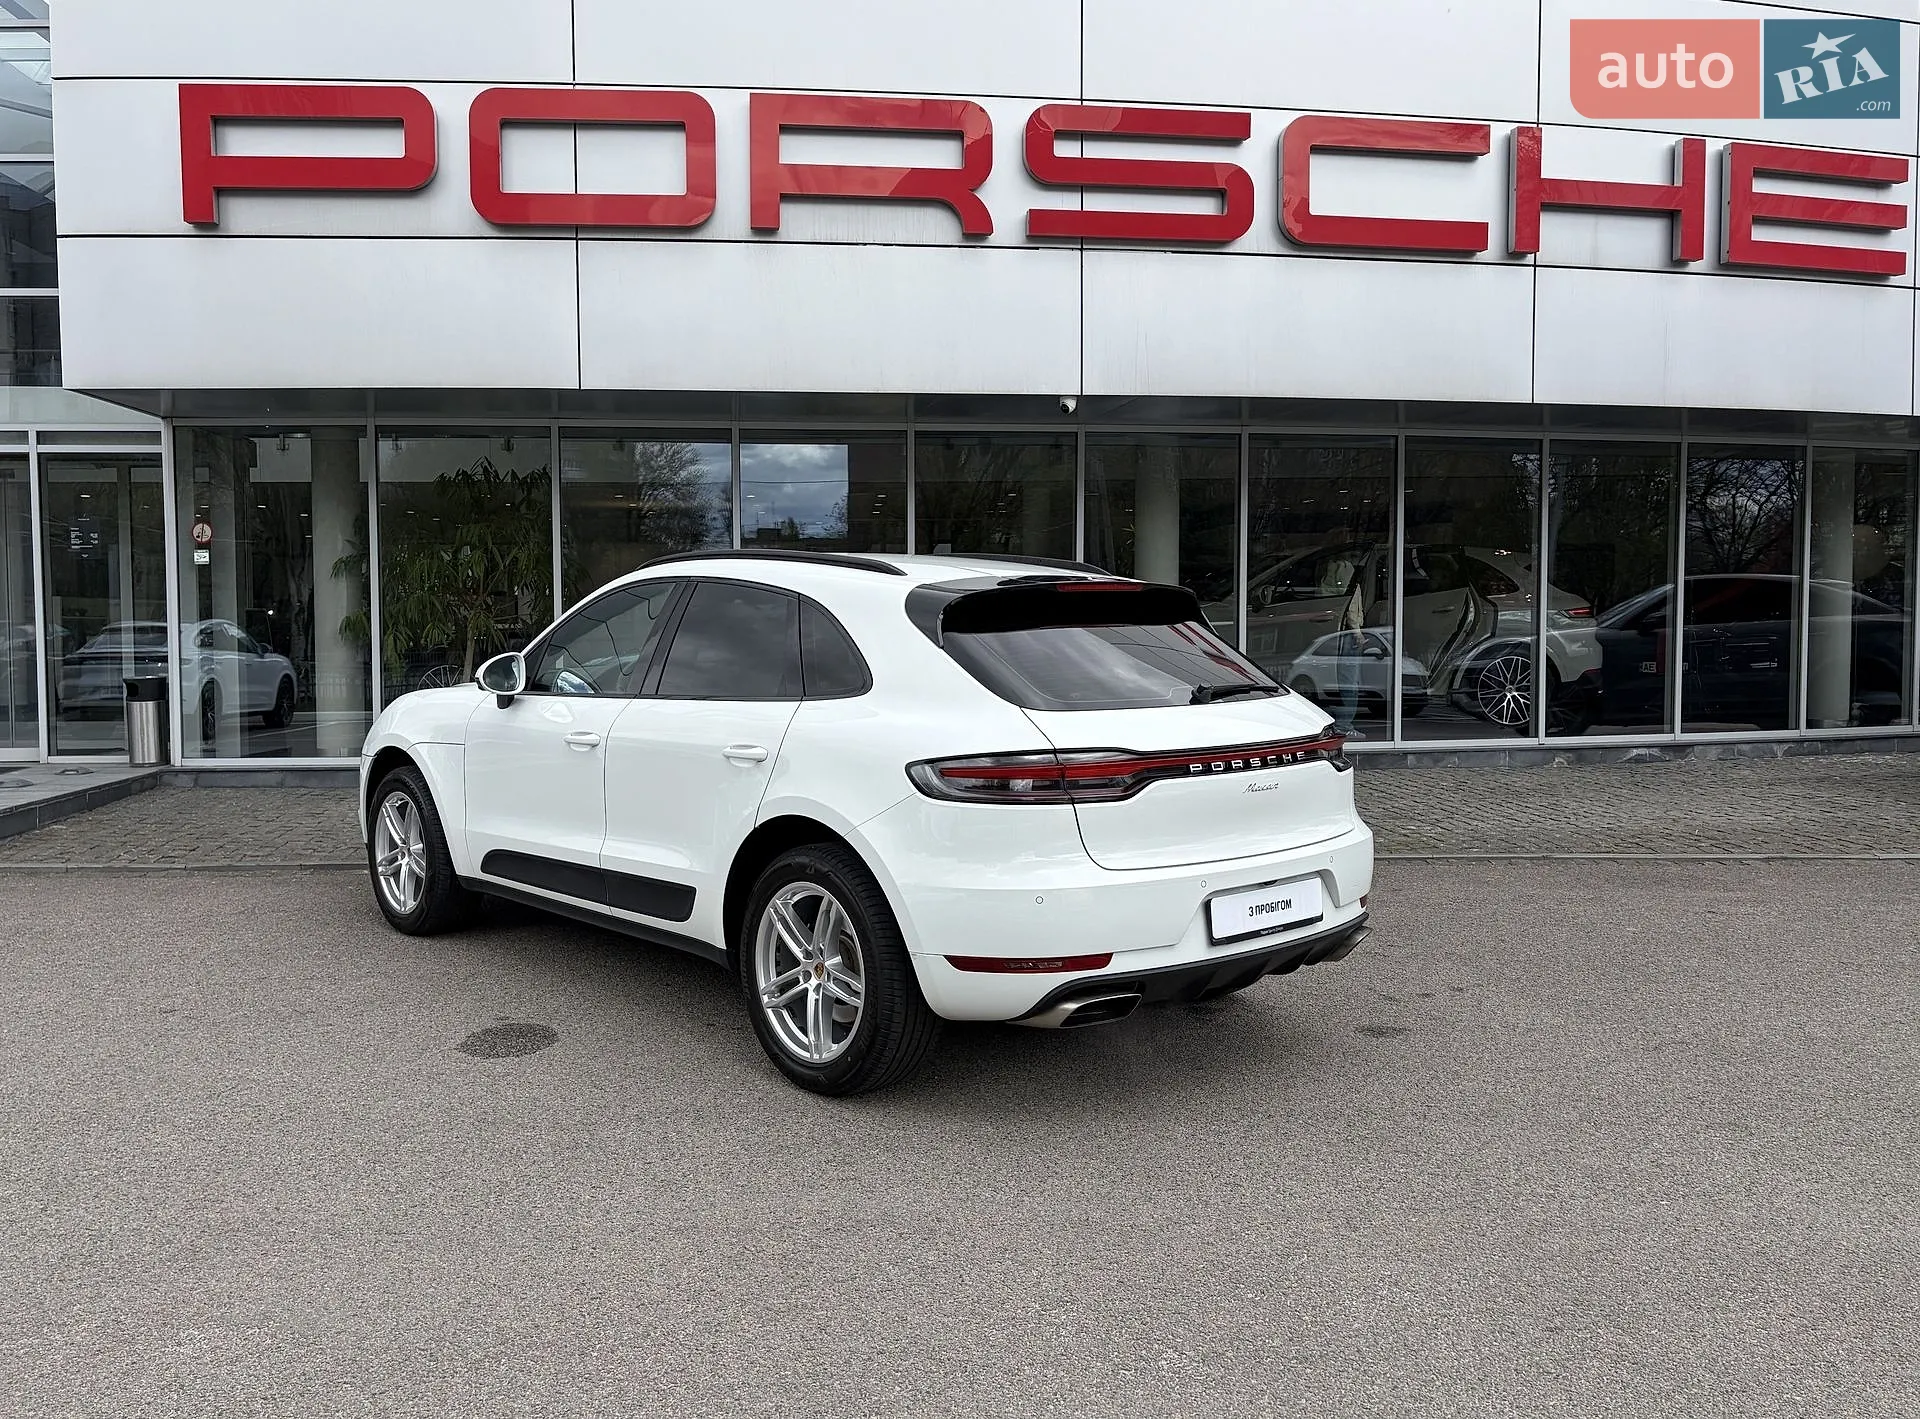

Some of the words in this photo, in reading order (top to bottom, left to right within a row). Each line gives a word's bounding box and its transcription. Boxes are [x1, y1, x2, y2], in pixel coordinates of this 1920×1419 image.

[179, 84, 1908, 276] PORSCHE
[1189, 751, 1306, 774] PORSCHE
[1256, 899, 1292, 916] ПРОБІГОМ
